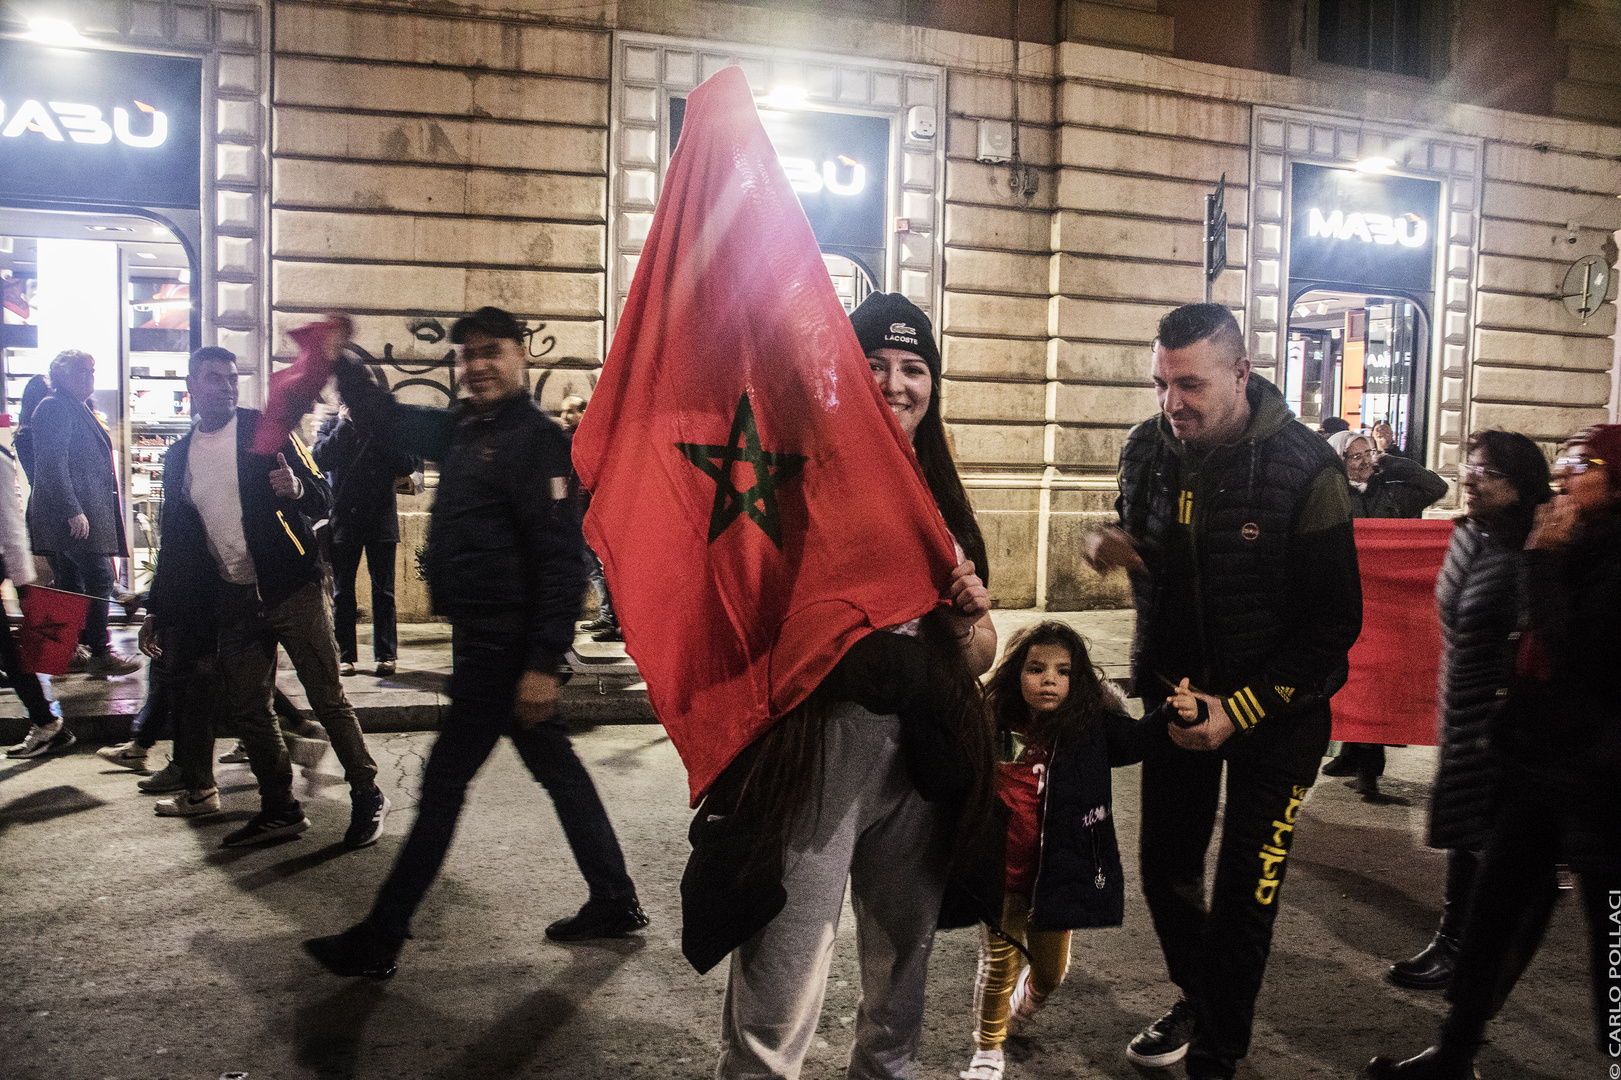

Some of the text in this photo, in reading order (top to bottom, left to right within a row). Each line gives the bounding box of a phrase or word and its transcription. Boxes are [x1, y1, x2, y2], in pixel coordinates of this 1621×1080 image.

[0, 99, 168, 148] ABÙ
[778, 154, 866, 196] BÙ
[1308, 207, 1428, 248] MABÙ
[884, 334, 919, 345] LACOSTE
[1255, 784, 1310, 905] adidas
